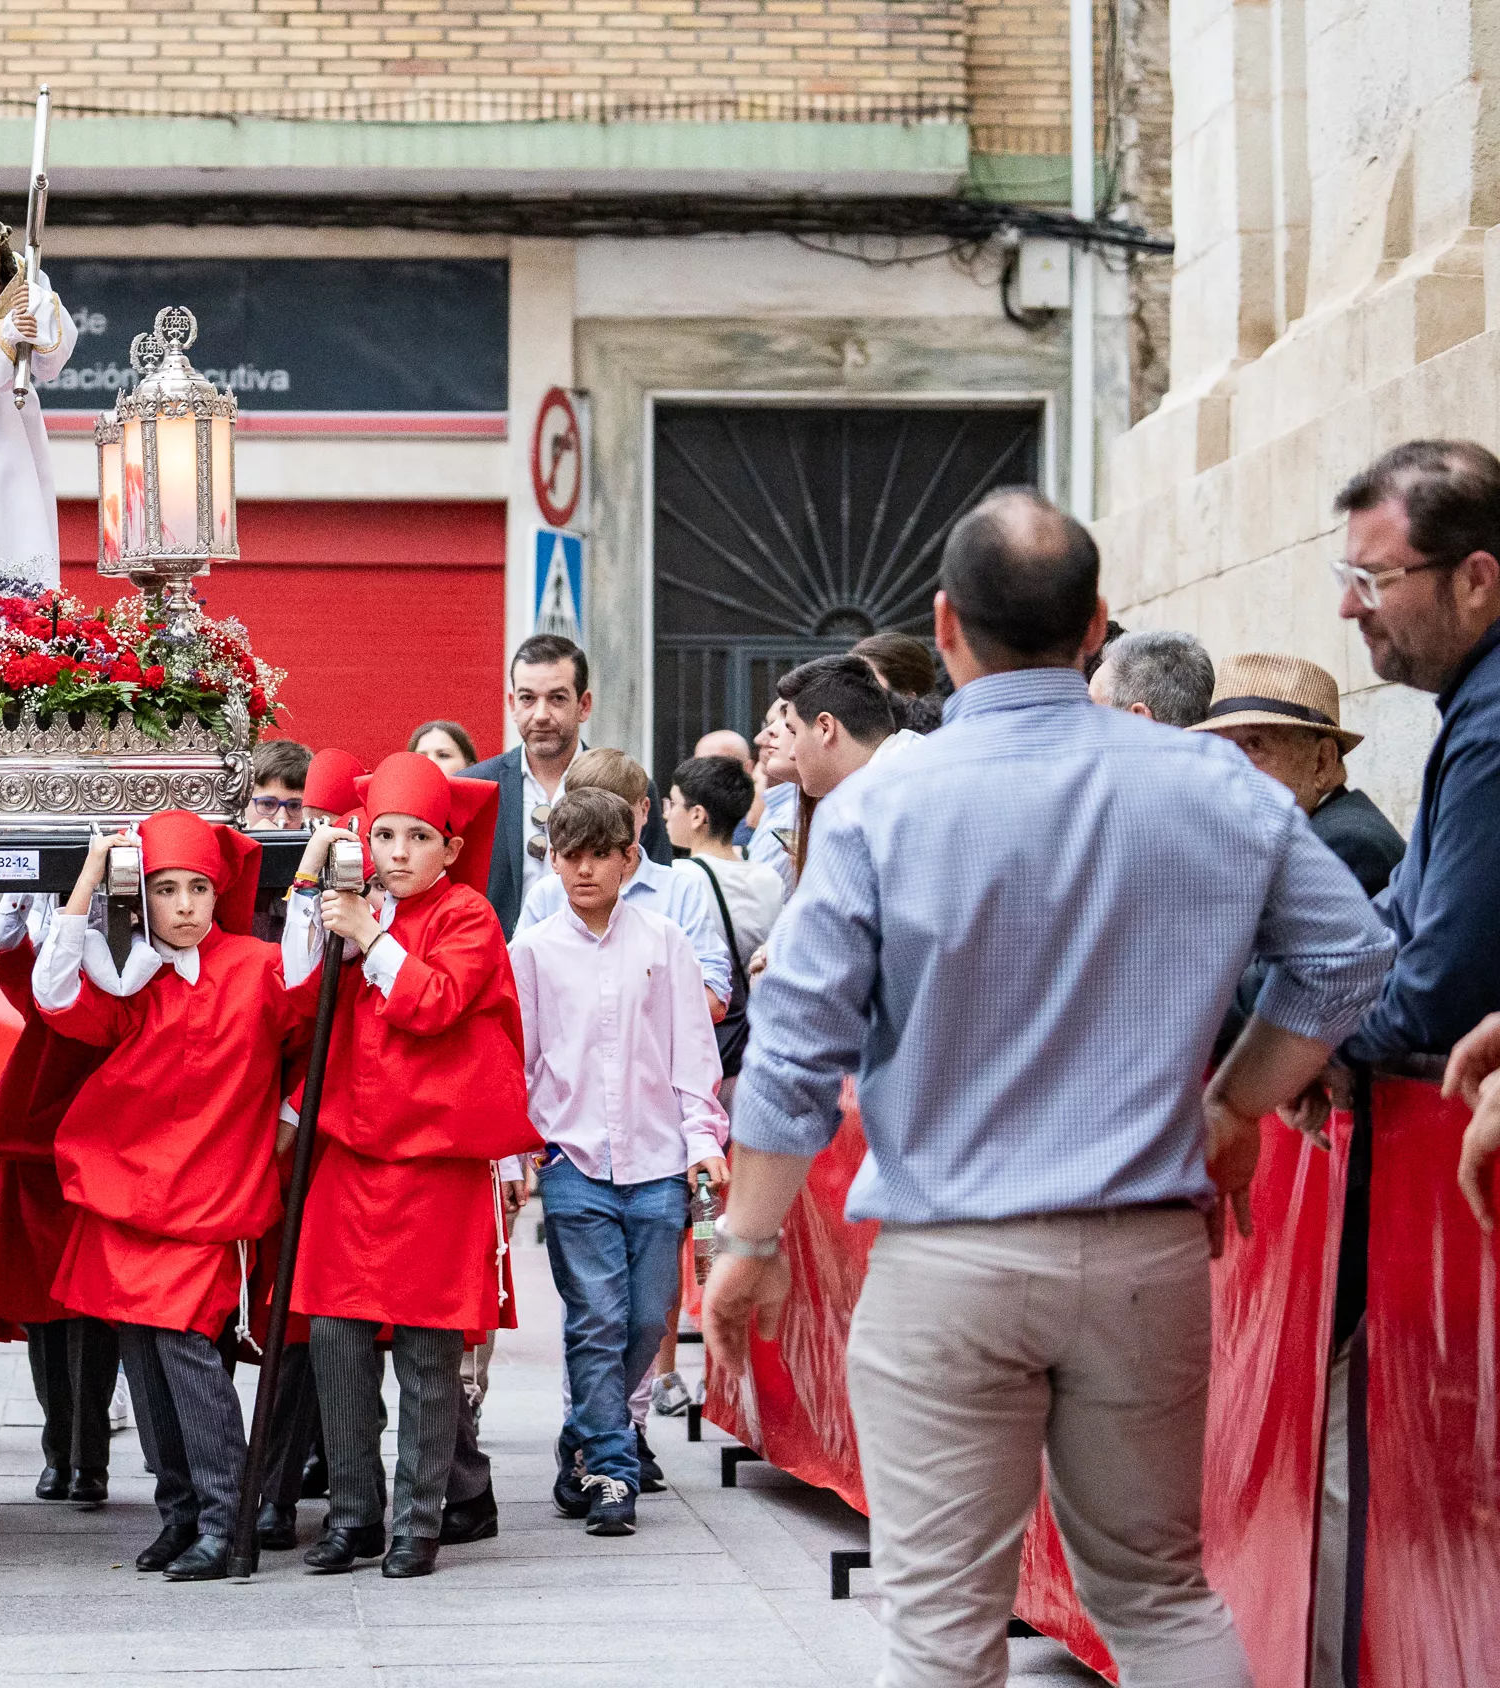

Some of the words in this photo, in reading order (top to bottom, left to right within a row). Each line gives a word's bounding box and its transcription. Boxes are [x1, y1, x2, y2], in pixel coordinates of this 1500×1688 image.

[72, 306, 107, 335] de
[34, 361, 139, 391] ación
[194, 363, 290, 391] cutiva
